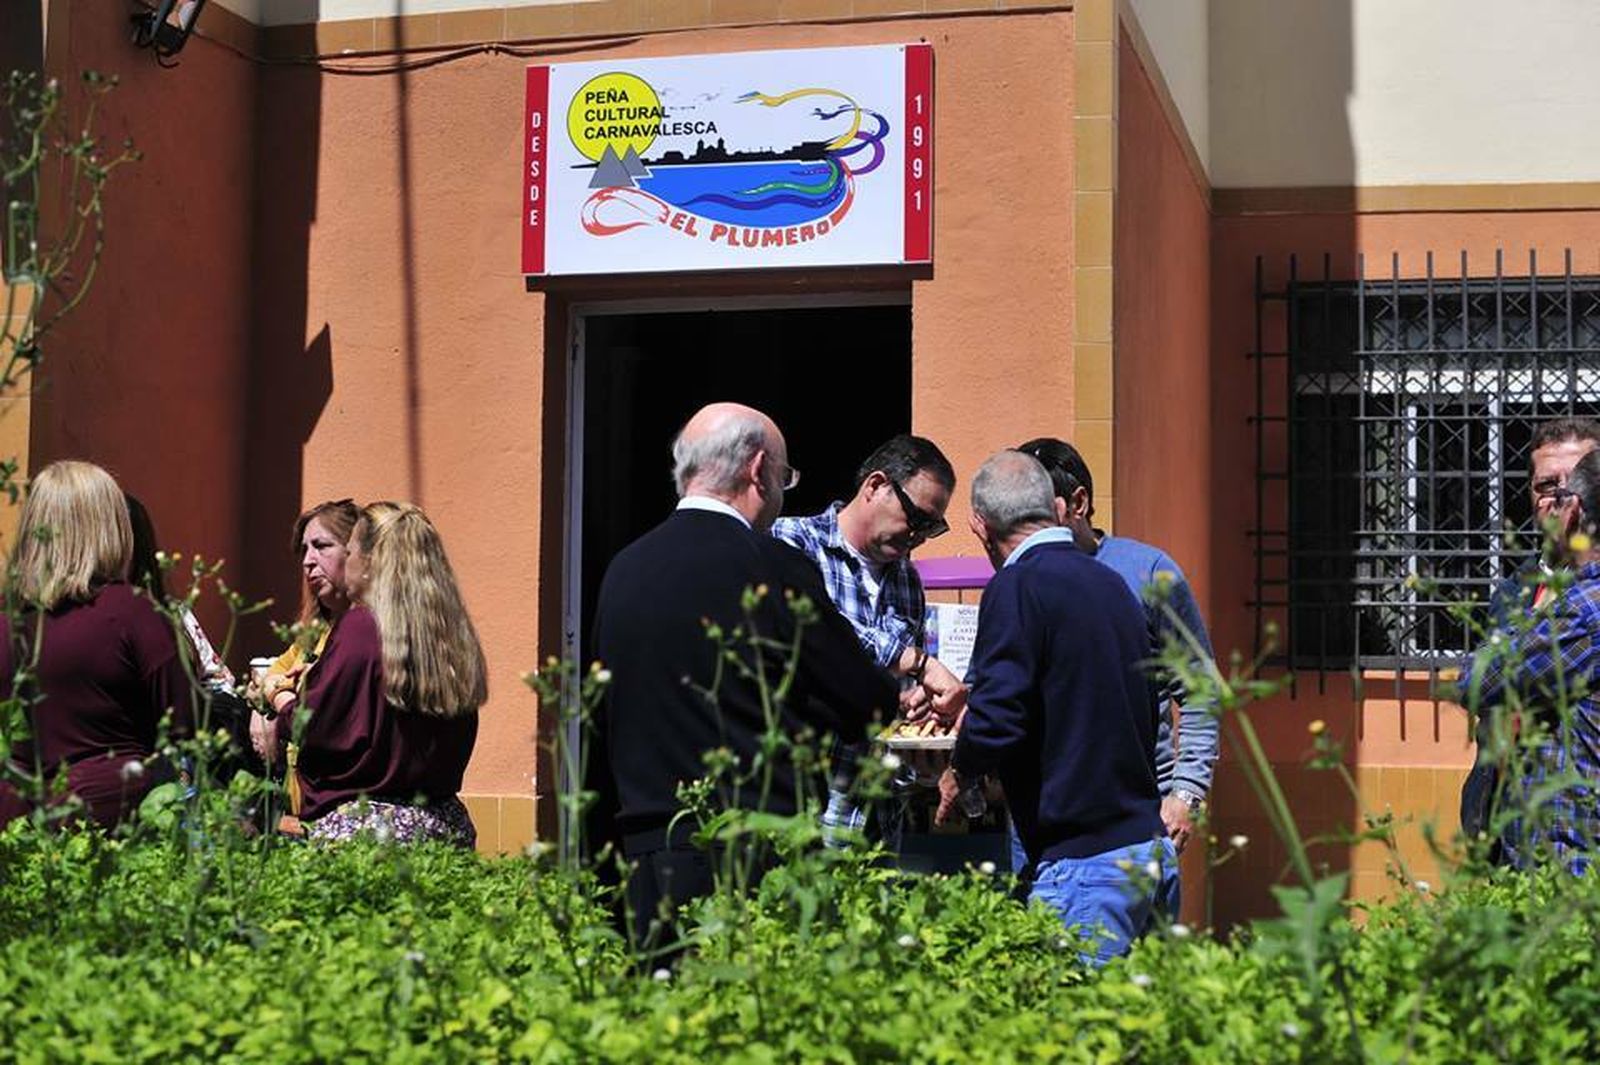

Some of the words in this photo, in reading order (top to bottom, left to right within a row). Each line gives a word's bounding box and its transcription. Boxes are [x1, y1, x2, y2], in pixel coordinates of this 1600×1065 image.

[585, 88, 629, 104] PEÑA
[584, 106, 671, 122] CULTURAL
[584, 121, 717, 139] CARNAVALESCA
[913, 94, 923, 211] 1991
[530, 112, 541, 226] DESDE
[670, 213, 698, 237] EL
[709, 220, 830, 248] PLUMERO
